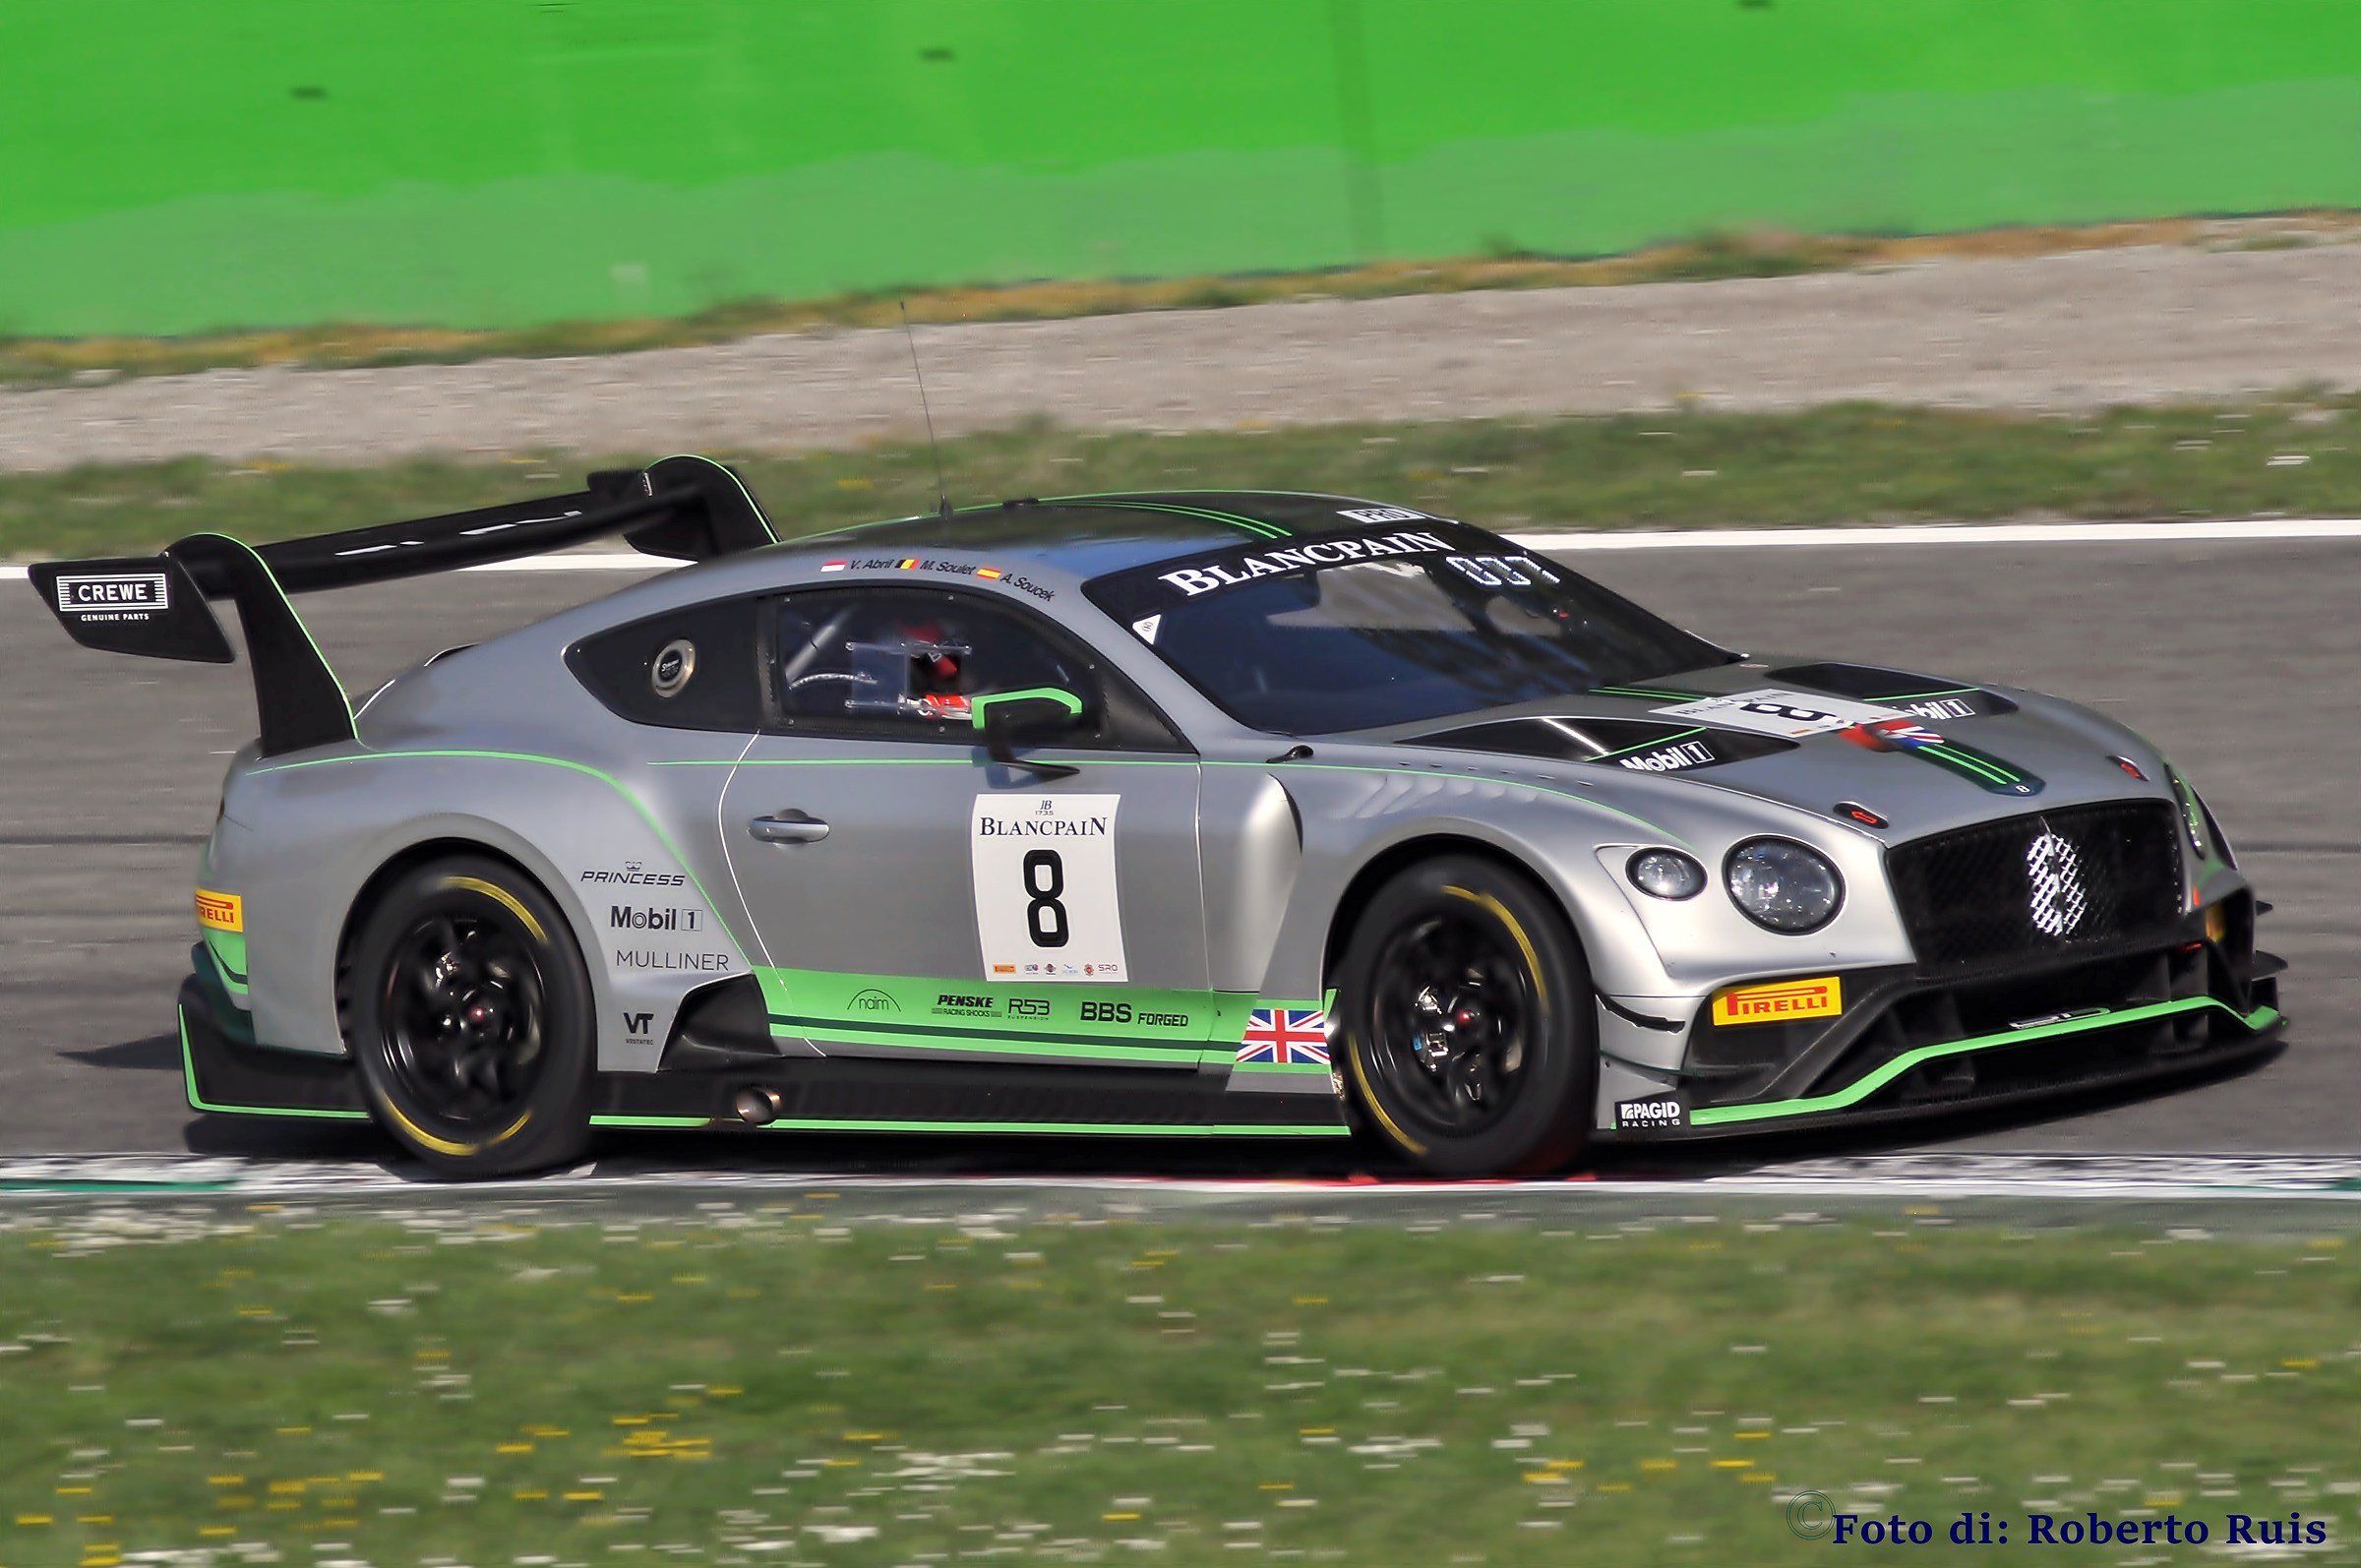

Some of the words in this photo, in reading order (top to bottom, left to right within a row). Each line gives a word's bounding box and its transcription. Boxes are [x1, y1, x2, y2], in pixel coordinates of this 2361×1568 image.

[863, 558, 893, 570] Abril
[938, 561, 976, 575] Soulet
[1157, 531, 1456, 596] BLANCPAIN
[78, 583, 149, 602] CREWE
[1013, 576, 1056, 603] Soucek
[1739, 702, 1839, 721] 8
[1620, 747, 1694, 771] Mobil
[979, 816, 1108, 837] BLANCPAIN
[580, 871, 686, 886] PRINCESS
[1023, 849, 1069, 948] 8
[197, 906, 235, 924] RELLI
[611, 905, 677, 931] Mobil
[616, 949, 729, 972] MULLINER
[1098, 964, 1119, 973] SRO
[858, 996, 889, 1010] naim
[937, 995, 994, 1008] PENSKE
[1008, 998, 1050, 1015] R53
[1726, 986, 1828, 1016] PIRELLI
[943, 1008, 965, 1017] RACING
[966, 1008, 991, 1018] SHOCKS
[1080, 1001, 1131, 1023] BBS
[1137, 1012, 1188, 1027] FORGED
[623, 1012, 654, 1034] VT
[1634, 1102, 1680, 1119] PAGID
[1622, 1118, 1681, 1127] RACING
